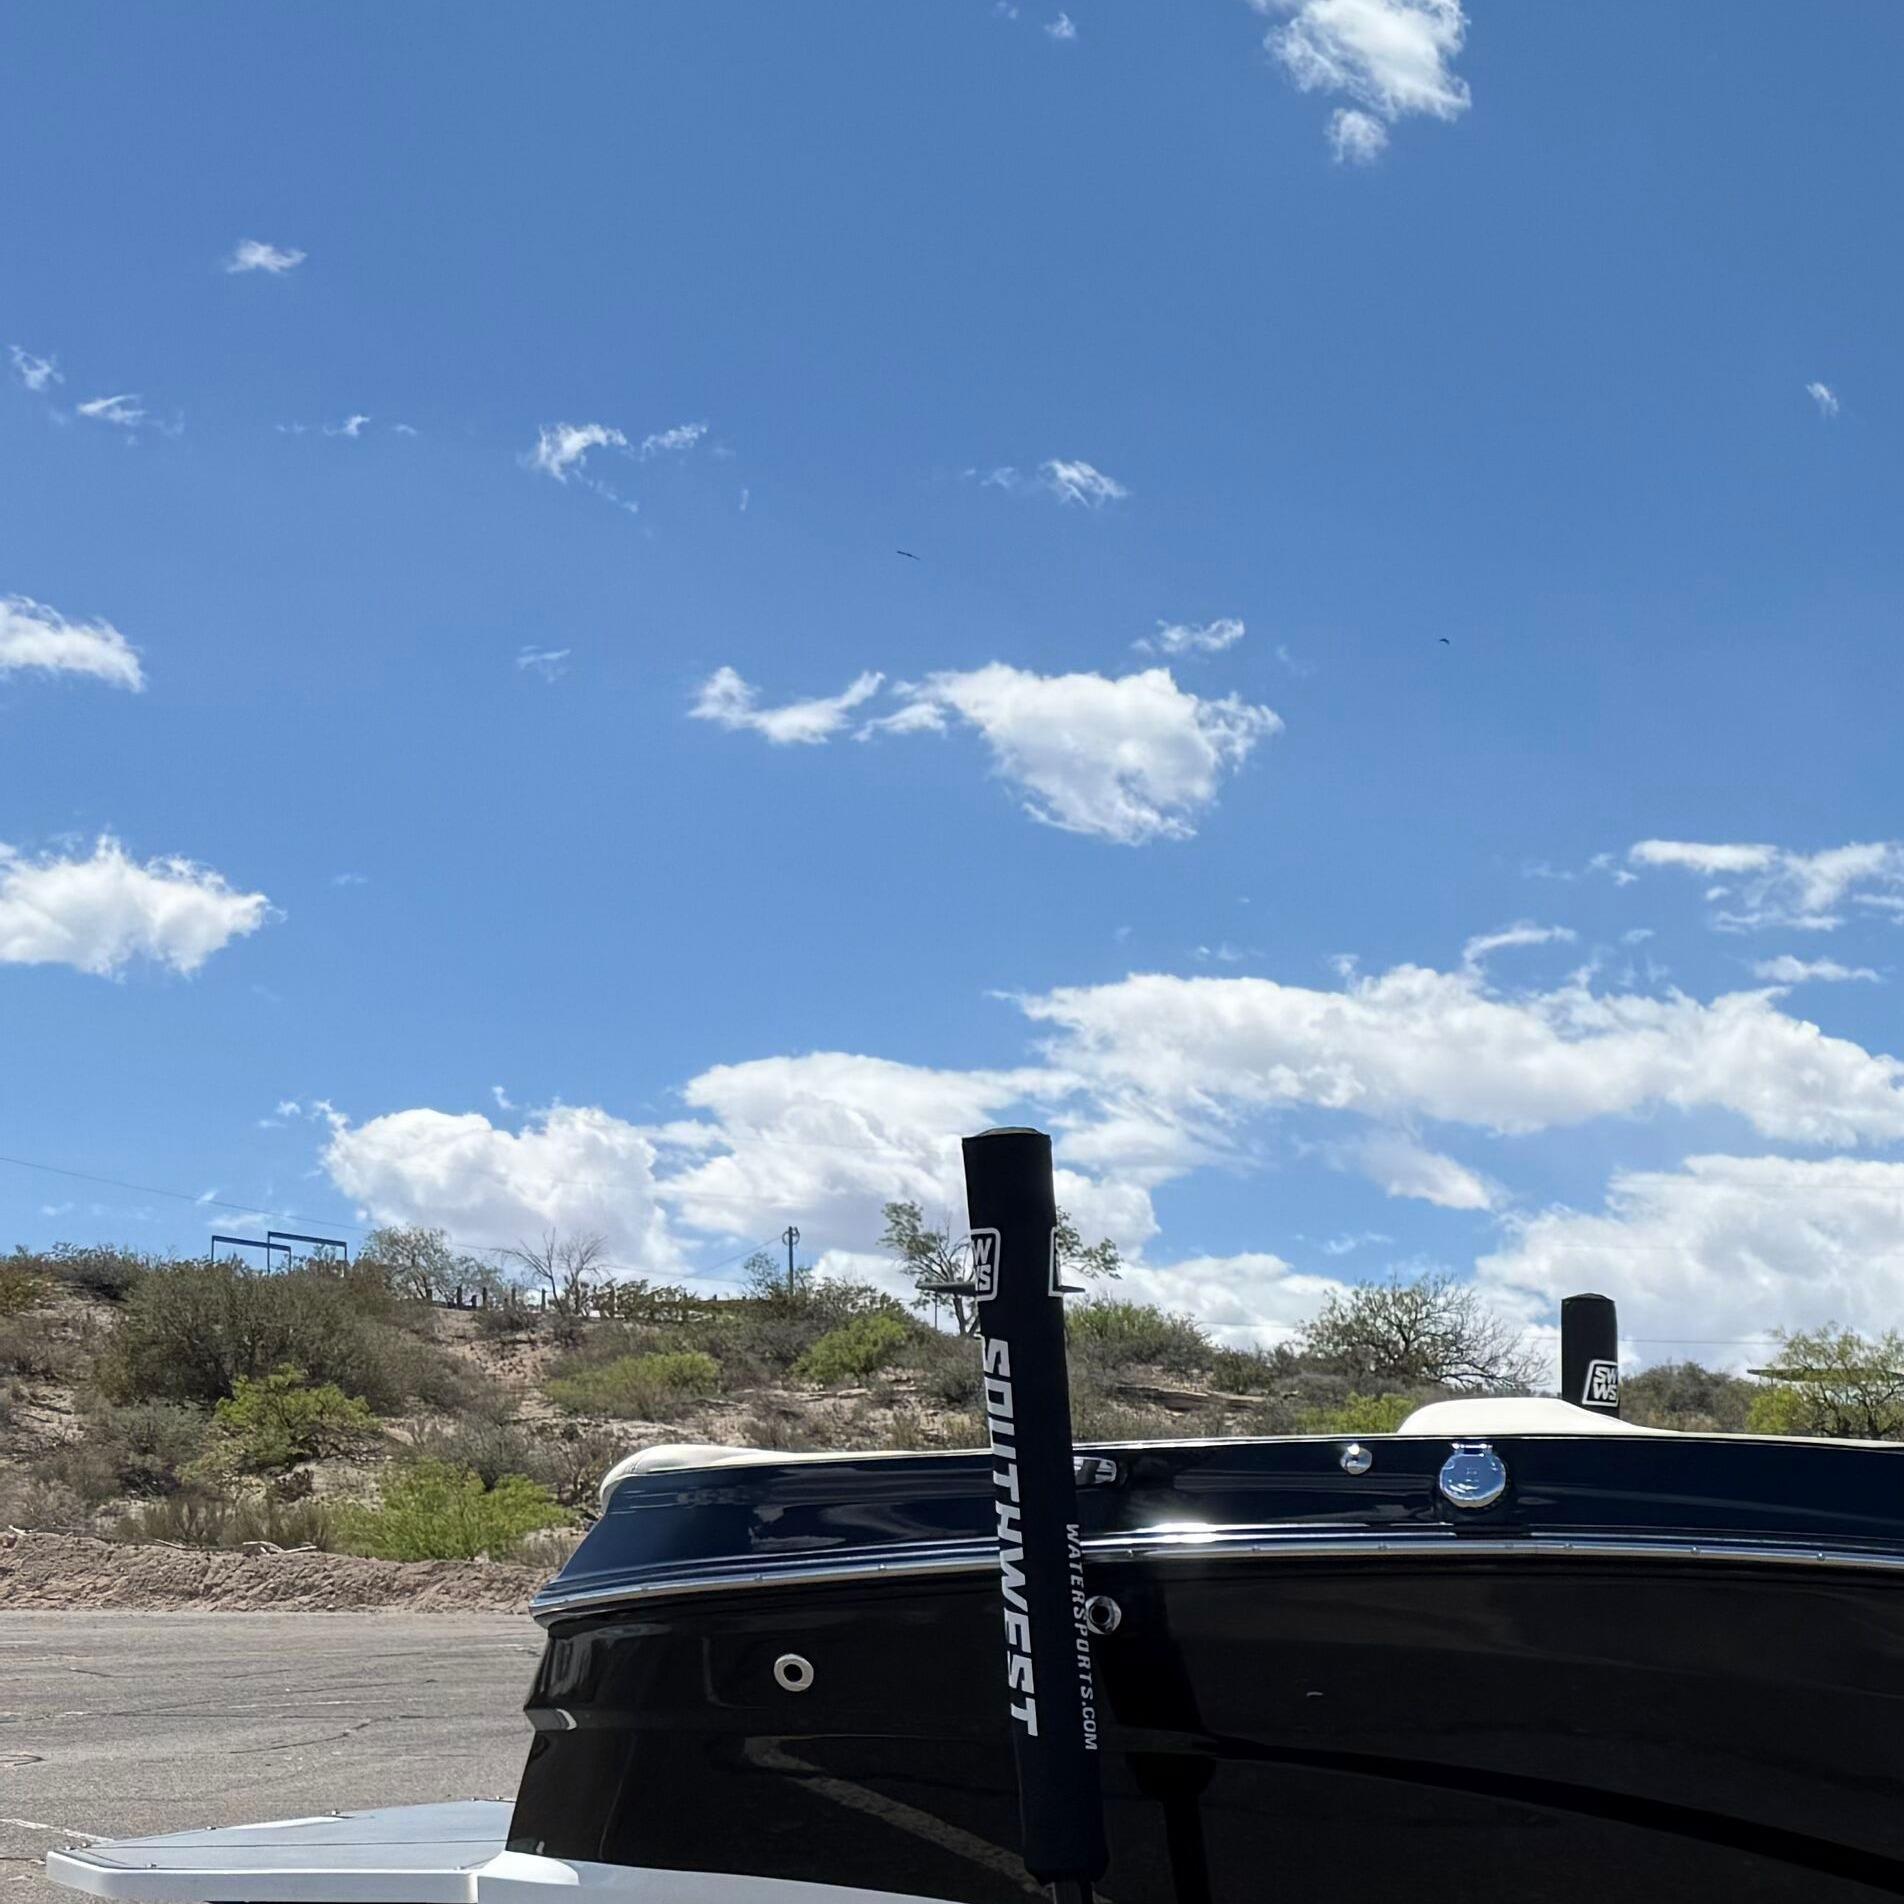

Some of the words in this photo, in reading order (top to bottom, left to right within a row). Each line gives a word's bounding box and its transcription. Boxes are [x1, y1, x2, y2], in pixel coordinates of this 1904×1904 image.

[970, 1237, 993, 1266] W
[984, 1337, 1039, 1737] SOUTHWEST
[1065, 1523, 1098, 1750] WATERSPORTS.COM
